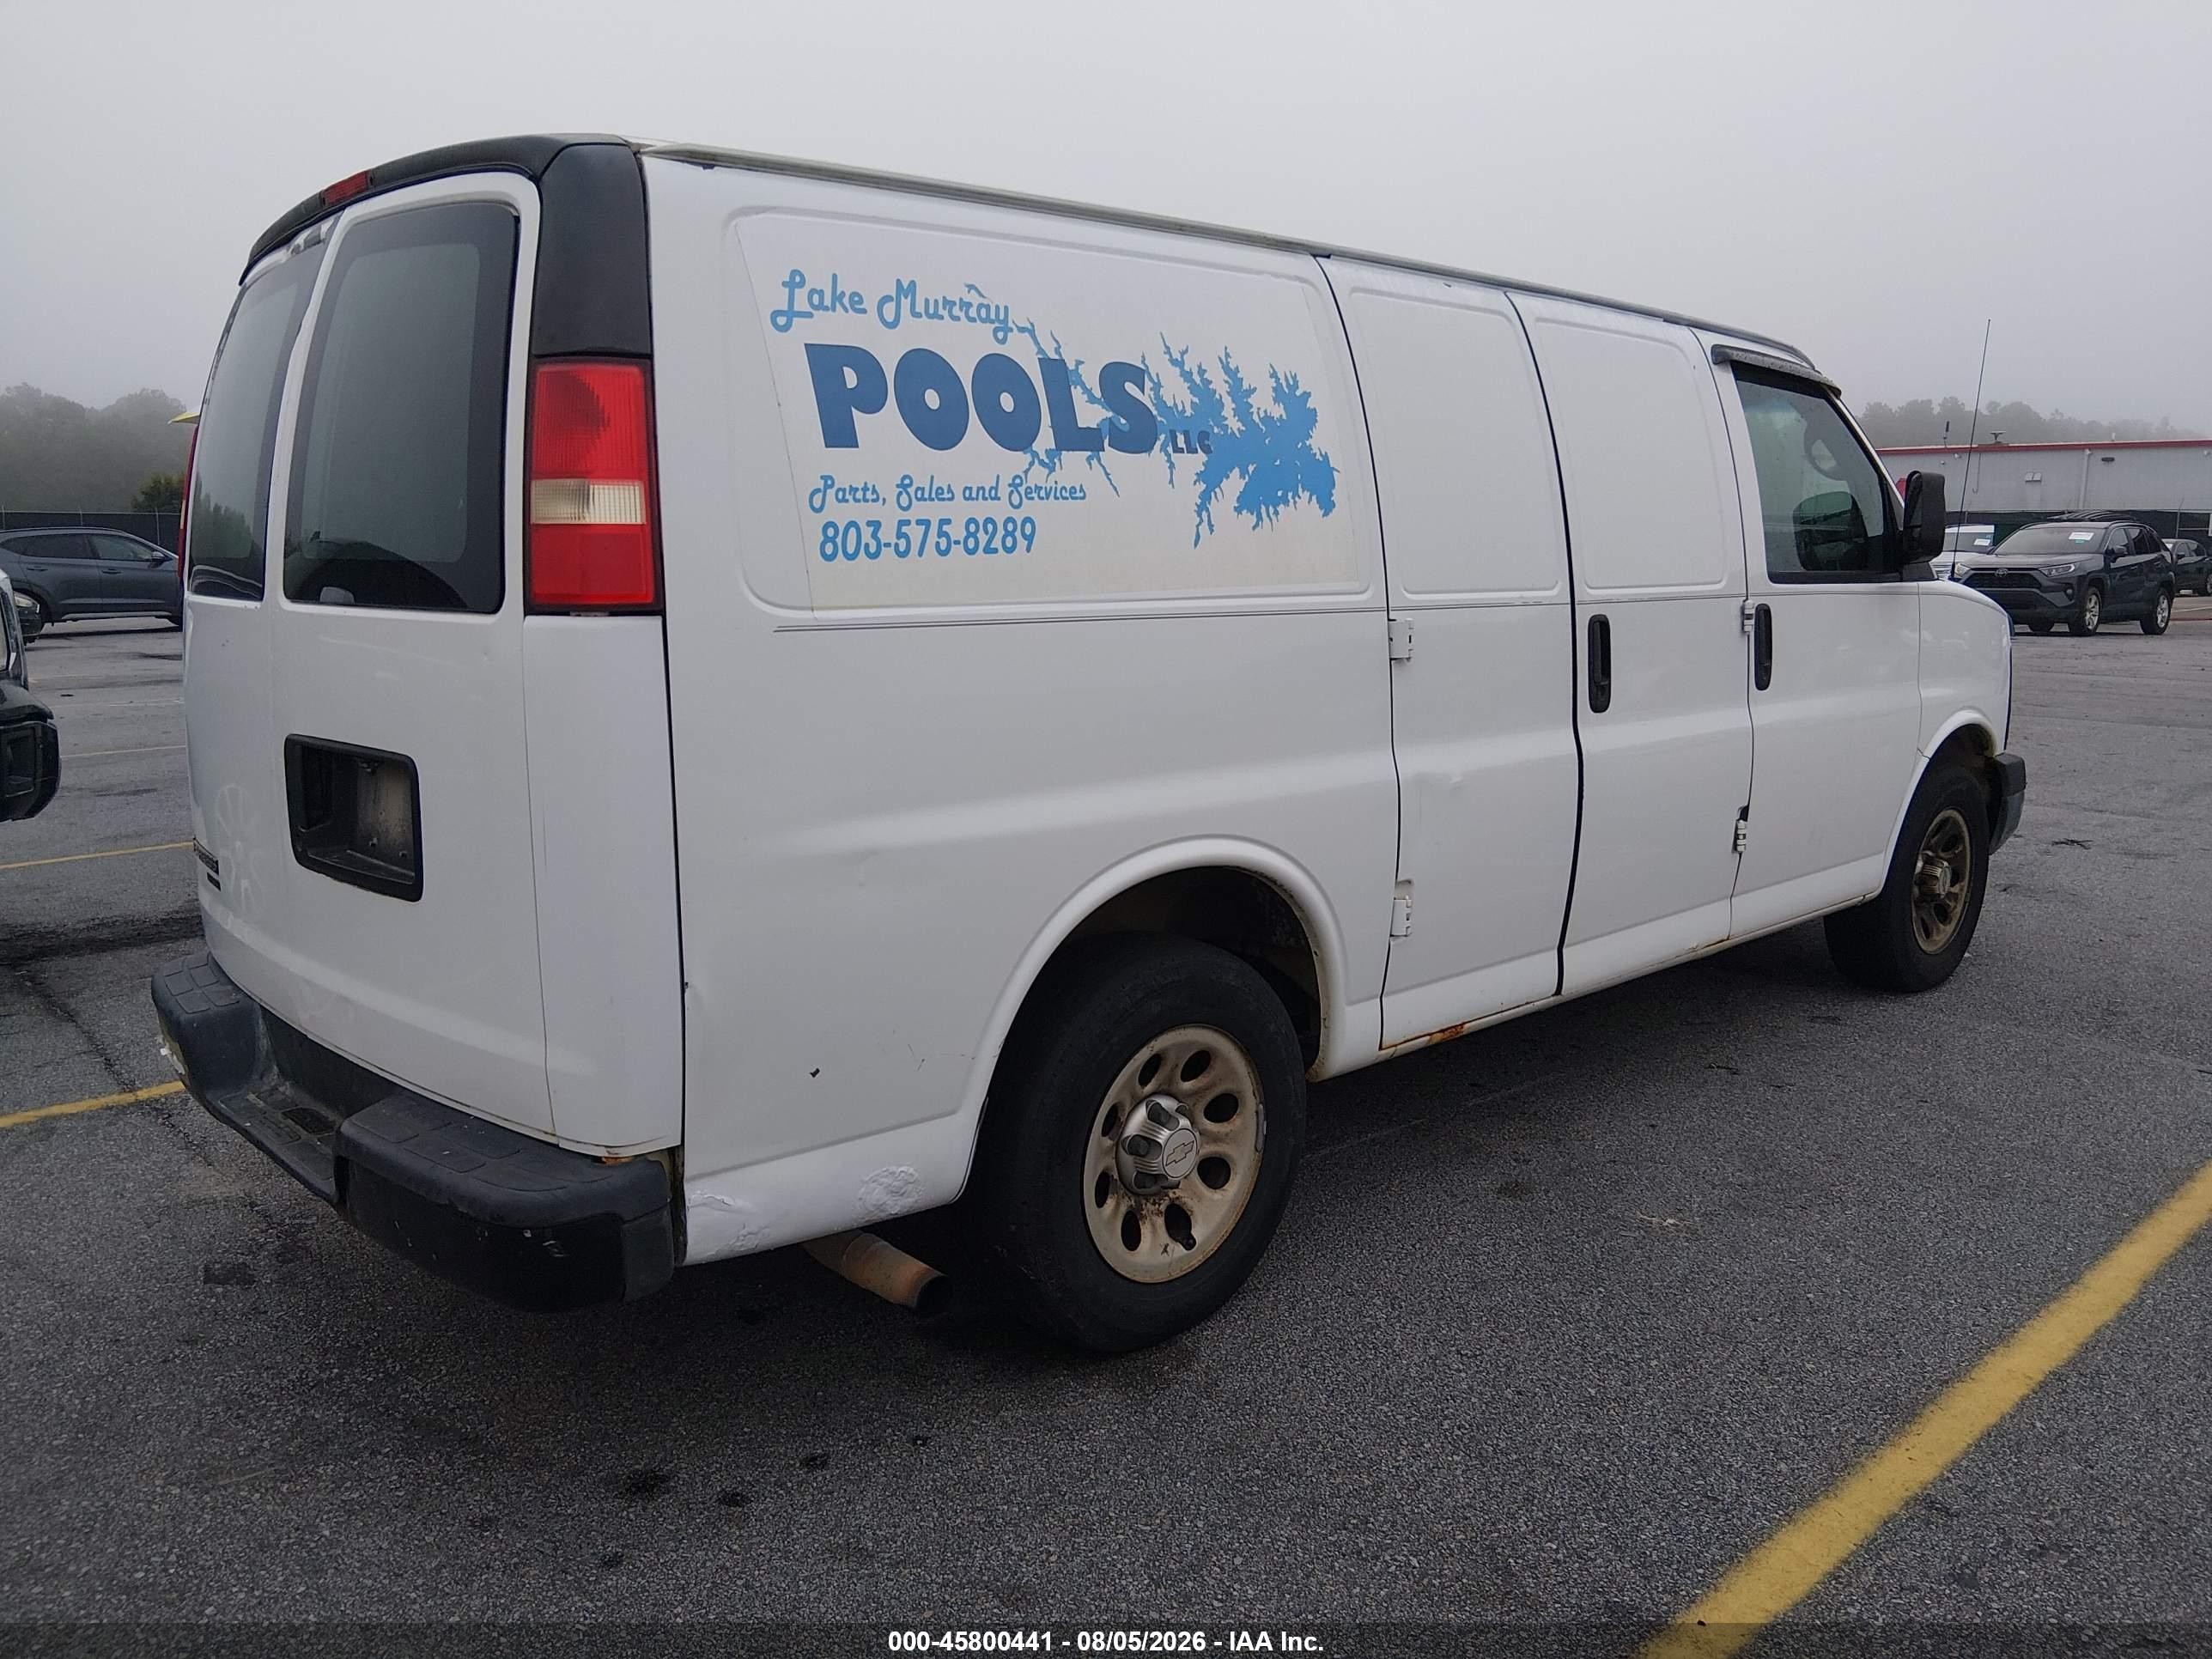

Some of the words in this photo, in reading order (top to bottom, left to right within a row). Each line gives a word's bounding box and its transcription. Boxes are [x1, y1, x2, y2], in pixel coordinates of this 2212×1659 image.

[770, 269, 867, 332] Lake
[877, 278, 1013, 344] Murray
[804, 343, 1158, 454] POOLS
[1169, 429, 1213, 454] LLC
[808, 474, 887, 514] Parts,
[896, 474, 955, 512] Sales
[962, 474, 1001, 501] and
[1008, 474, 1086, 509] Services
[819, 516, 1036, 562] 803-575-8289
